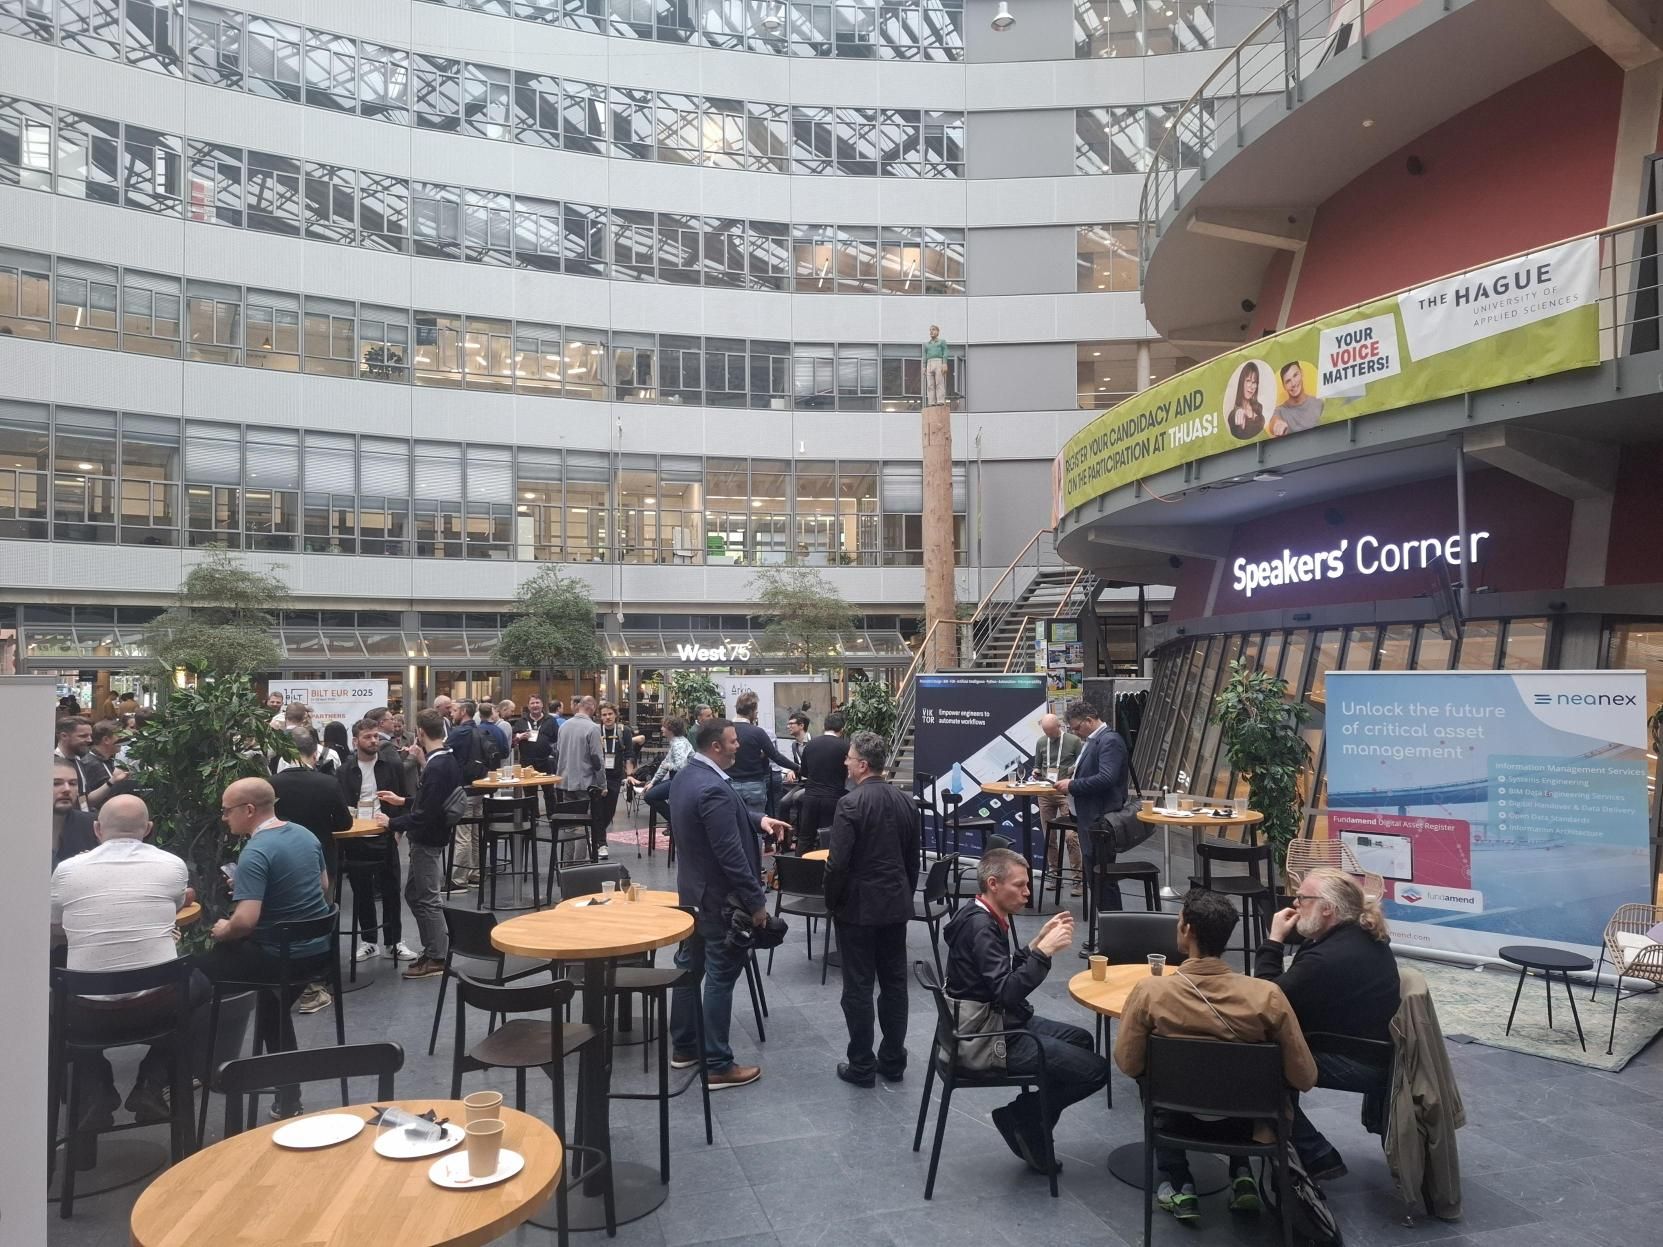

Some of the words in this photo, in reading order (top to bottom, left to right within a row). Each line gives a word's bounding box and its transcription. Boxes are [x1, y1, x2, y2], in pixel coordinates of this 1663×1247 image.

[1418, 293, 1447, 310] THE
[1455, 263, 1552, 308] HAGUE
[1473, 291, 1538, 315] UNIVERSITY
[1543, 287, 1559, 297] OF
[1473, 310, 1518, 327] APPLIED
[1523, 294, 1579, 314] SCIENCES
[1335, 326, 1373, 348] YOUR
[1330, 341, 1380, 369] VOICE
[1322, 355, 1390, 386] MATTERS!
[1089, 433, 1109, 459] YOUR
[1109, 401, 1172, 446] CANDIDACY
[1175, 389, 1204, 419] AND
[1088, 441, 1150, 484] PARTICIPATION
[1152, 431, 1167, 455] AT
[1168, 411, 1218, 448] THUAS!
[1233, 539, 1348, 598] Speakers'
[1356, 531, 1490, 575] Corner
[311, 689, 329, 697] BILT
[331, 689, 349, 697] EUR
[352, 689, 374, 697] 2025
[1557, 693, 1637, 707] neanex
[922, 708, 933, 716] VIK
[938, 709, 961, 718] Empower
[961, 711, 984, 719] engineers
[1342, 702, 1403, 717] Unlock
[1409, 702, 1440, 717] the
[1445, 703, 1506, 718] future
[922, 716, 935, 724] TOR
[1342, 722, 1360, 736] of
[1365, 722, 1428, 737] critical
[1434, 725, 1485, 739] asset
[1342, 743, 1463, 760] management
[1495, 761, 1545, 772] Information
[1547, 764, 1606, 775] Management
[1607, 767, 1646, 777] Services
[1542, 777, 1590, 788] Engineering
[1544, 791, 1590, 801] Engineering
[1333, 815, 1377, 826] Fundamend
[1378, 818, 1402, 829] Digital
[1403, 821, 1424, 830] Asset
[1424, 823, 1456, 833] Register
[1427, 892, 1475, 905] fundamend
[1388, 930, 1431, 943] mend.com
